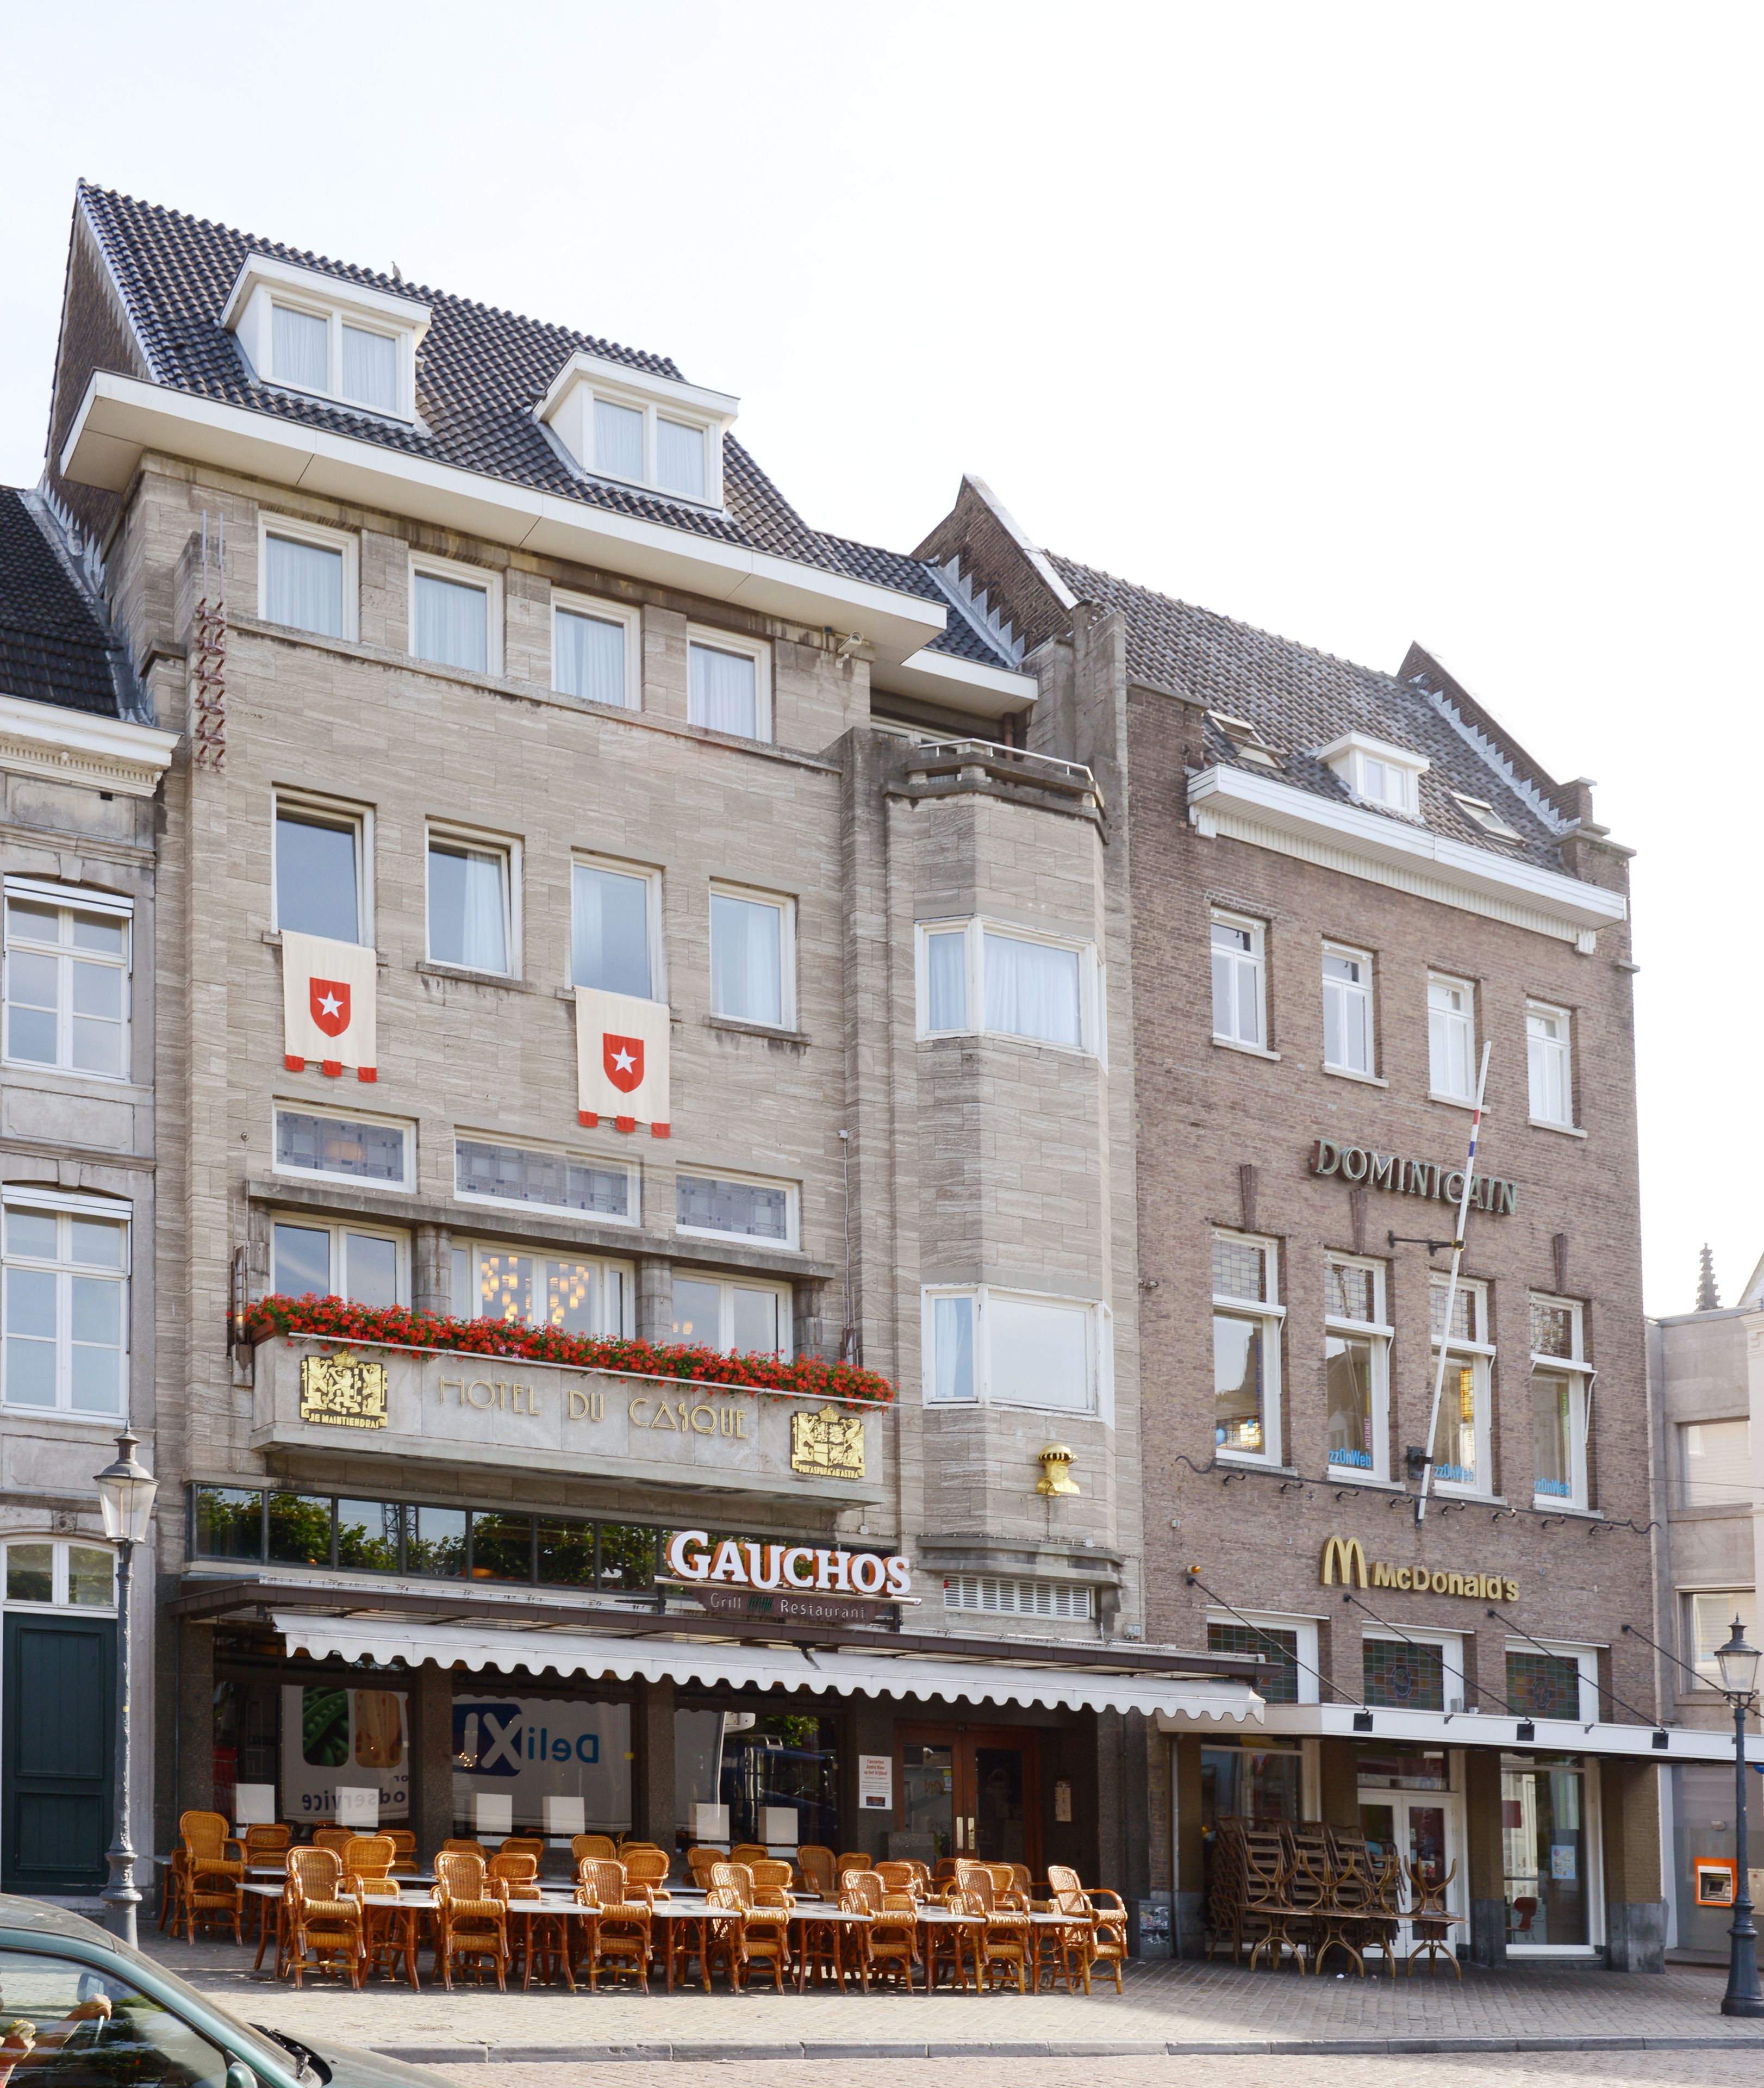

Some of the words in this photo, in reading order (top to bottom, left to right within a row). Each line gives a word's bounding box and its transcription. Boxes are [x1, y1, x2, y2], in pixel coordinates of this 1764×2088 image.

[1313, 1139, 1517, 1215] DOMINICAIN
[308, 1413, 320, 1422] JE
[440, 1375, 542, 1415] HOTEL
[569, 1390, 604, 1421] DU
[628, 1397, 749, 1438] CASQUE
[666, 1531, 911, 1594] GAUCHOS
[1372, 1562, 1520, 1601] McDonald's
[710, 1593, 741, 1609] Grill
